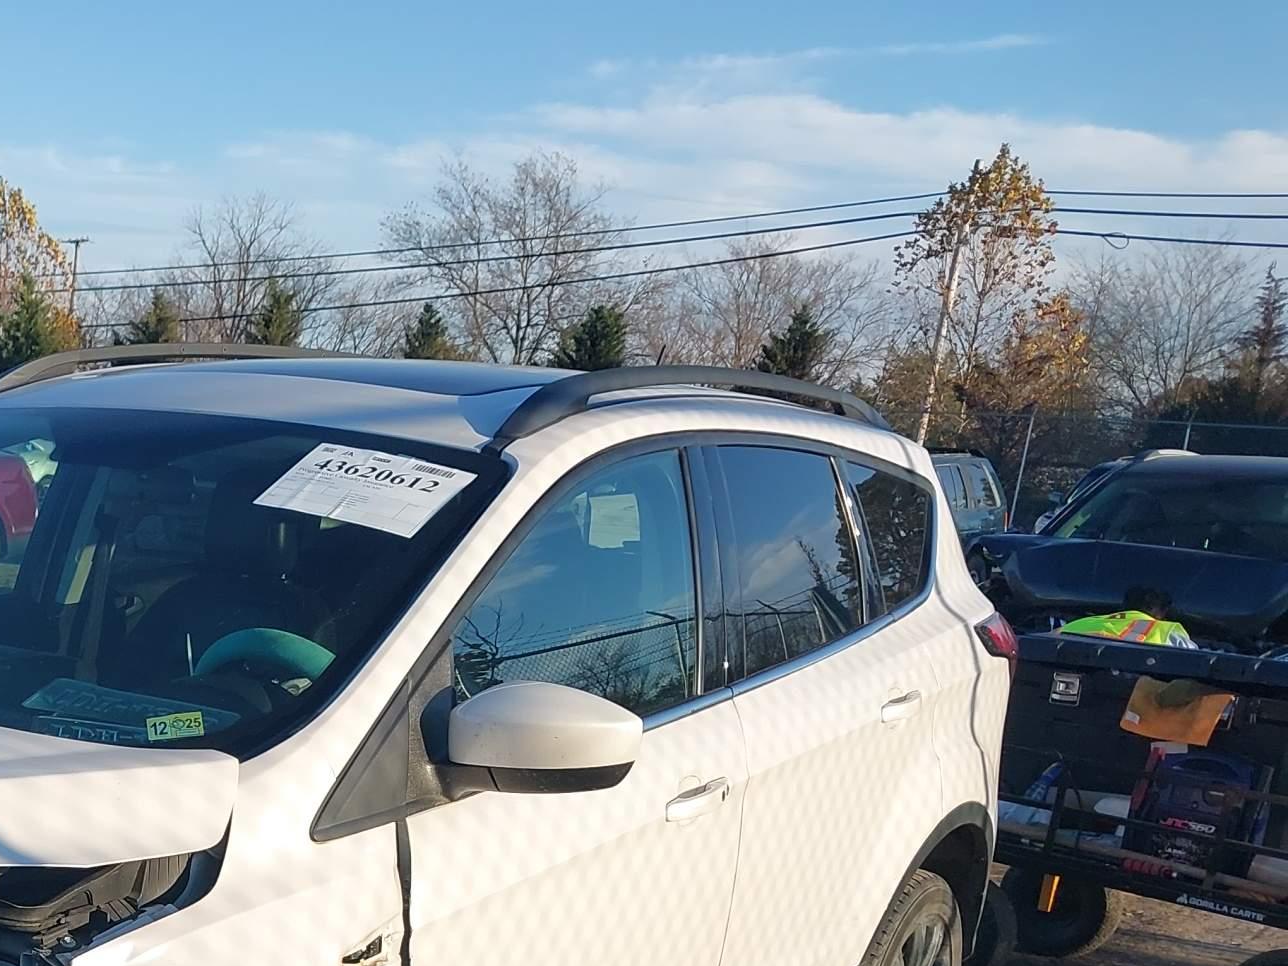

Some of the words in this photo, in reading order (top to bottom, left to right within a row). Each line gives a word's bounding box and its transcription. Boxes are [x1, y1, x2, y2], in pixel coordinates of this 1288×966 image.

[313, 457, 441, 493] 43620612
[150, 721, 168, 736] 12
[185, 717, 202, 729] 25
[1188, 896, 1228, 914] GORILLA
